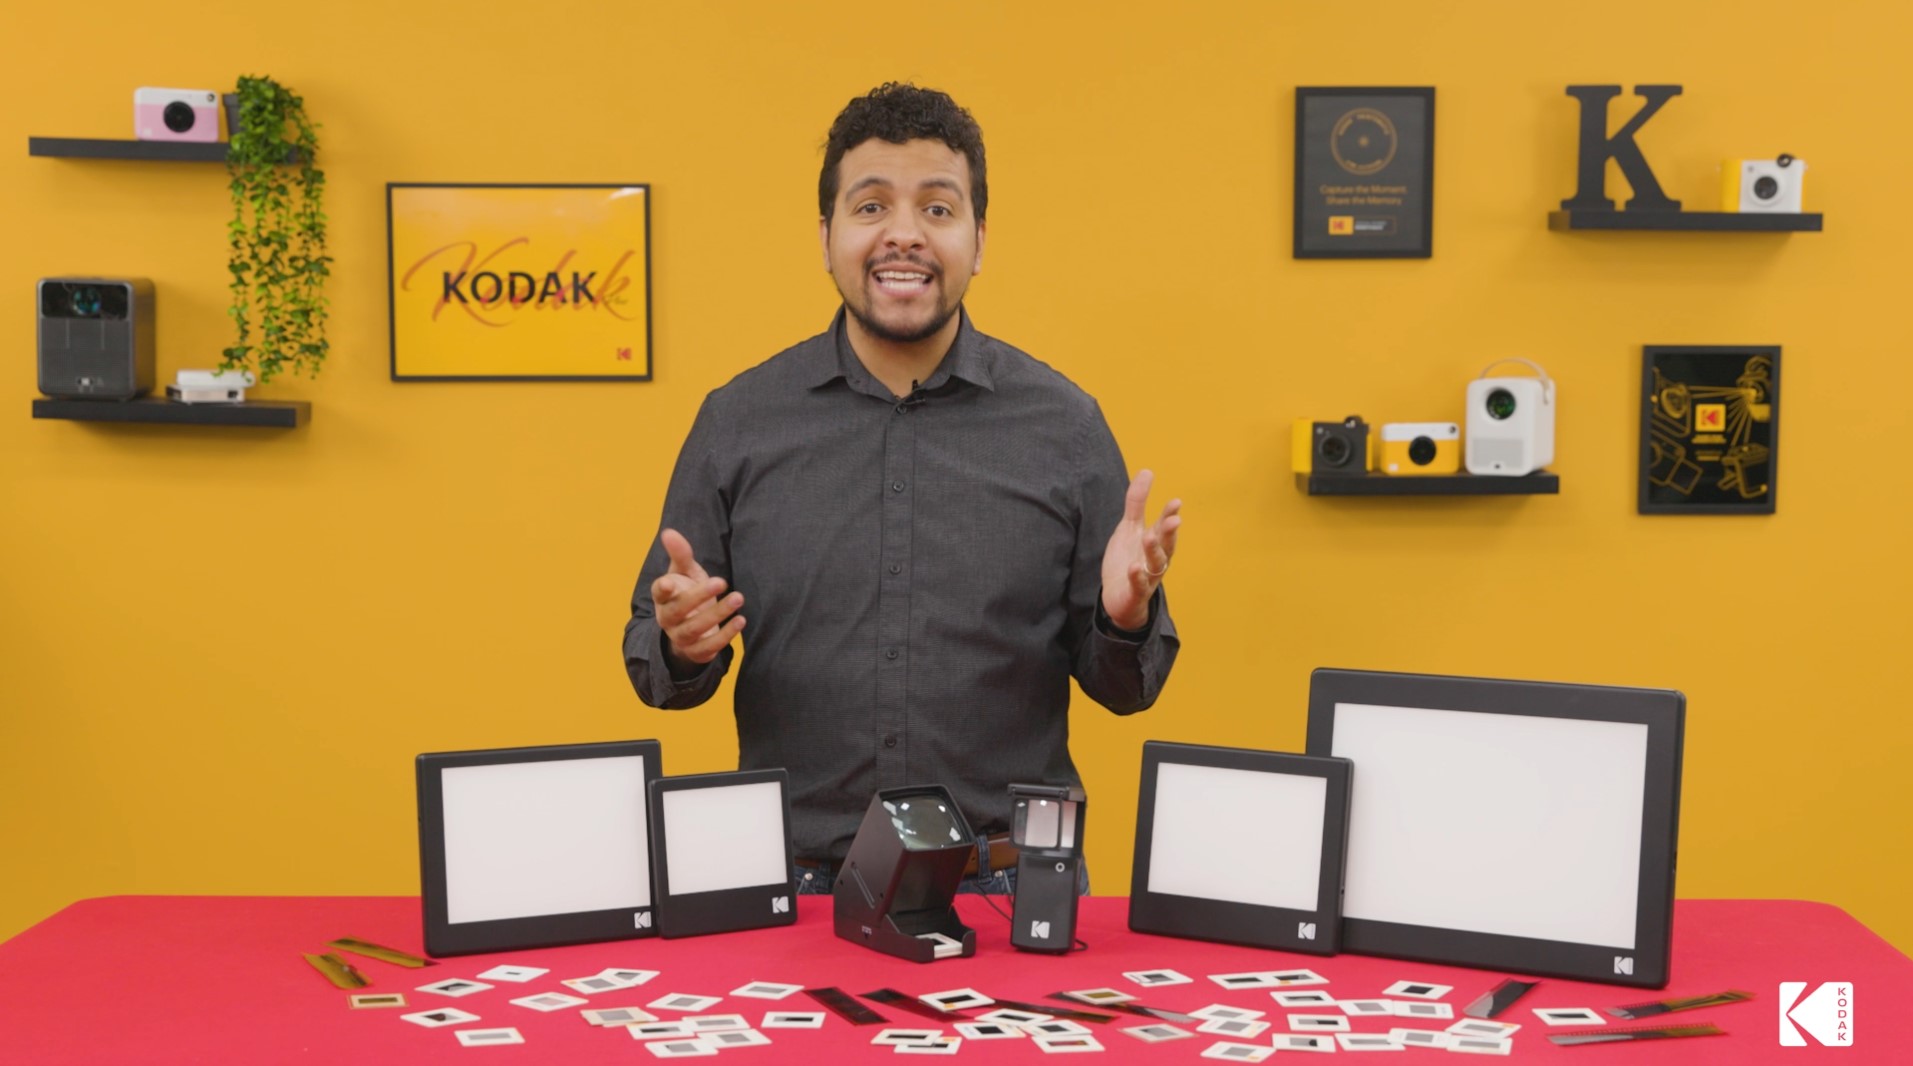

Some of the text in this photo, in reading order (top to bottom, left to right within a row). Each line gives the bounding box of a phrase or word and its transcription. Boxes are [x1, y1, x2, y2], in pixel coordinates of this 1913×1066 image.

[1561, 85, 1683, 211] K
[1355, 184, 1369, 194] the
[1352, 195, 1366, 205] the
[442, 271, 597, 304] KODAK
